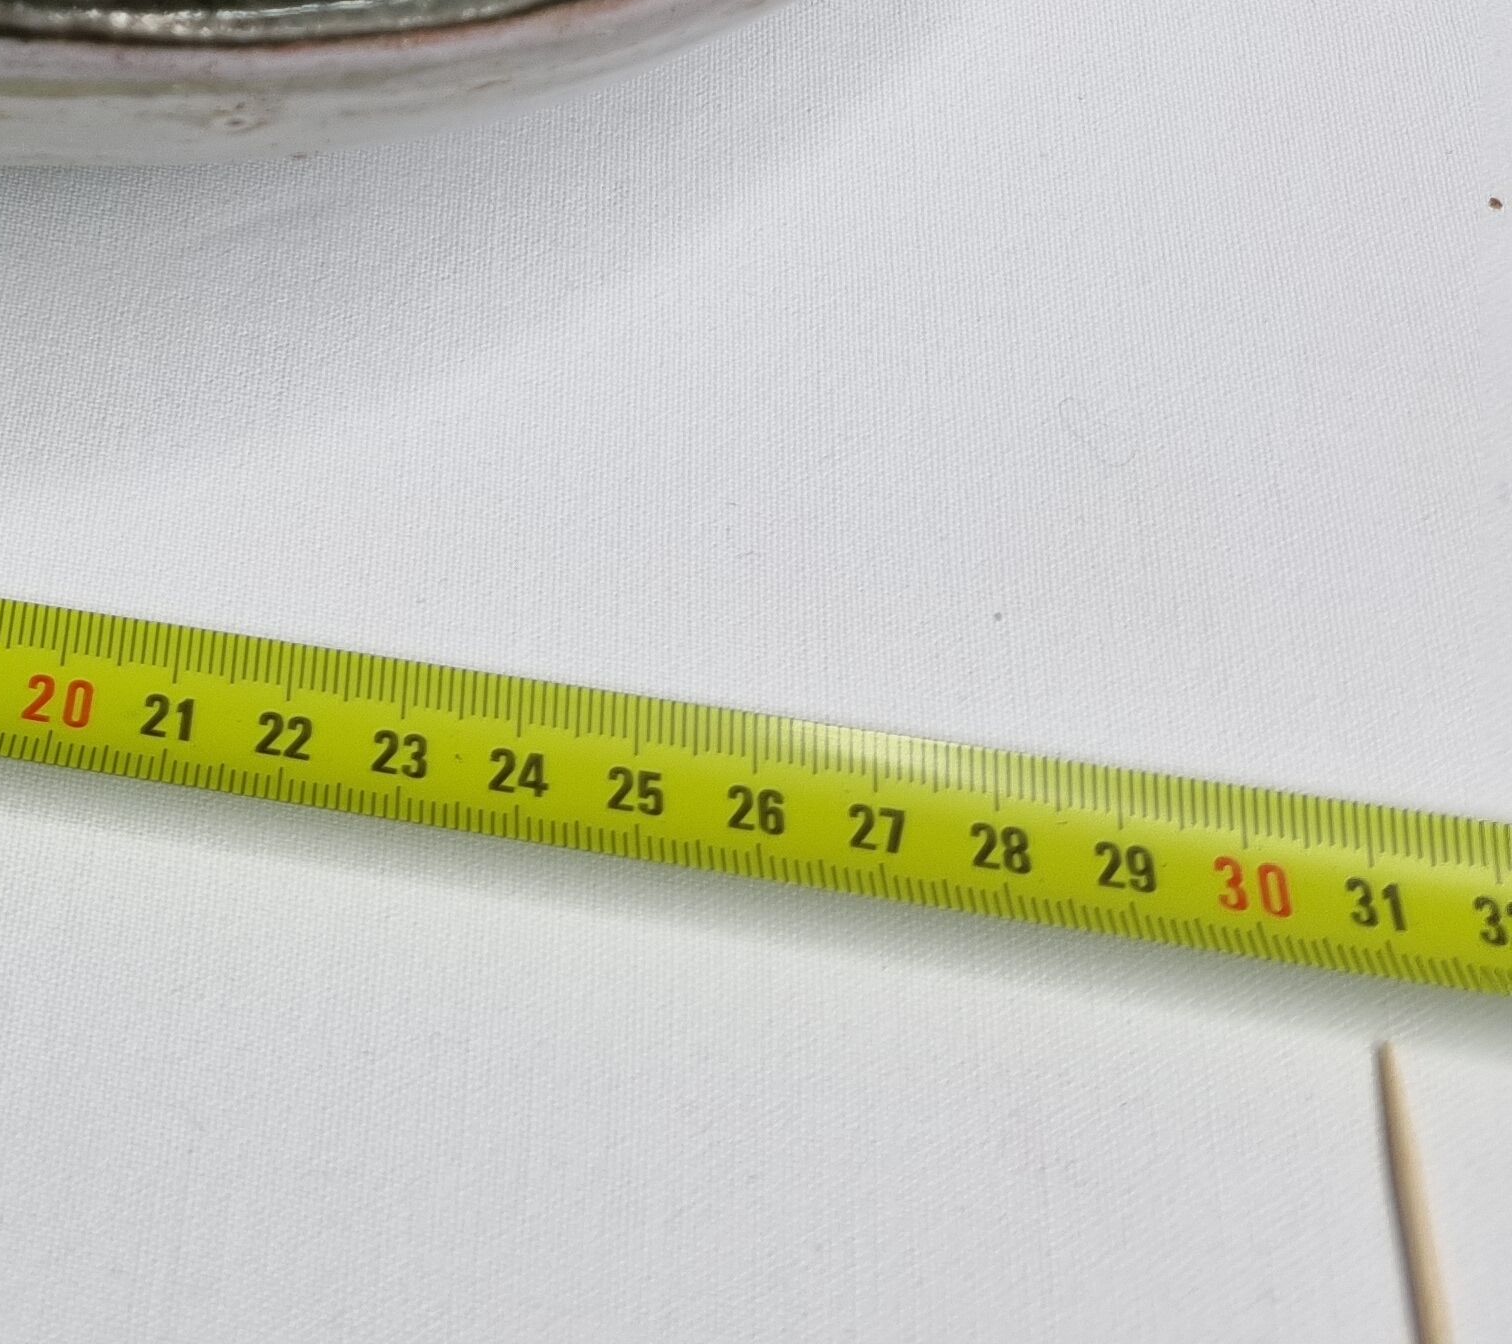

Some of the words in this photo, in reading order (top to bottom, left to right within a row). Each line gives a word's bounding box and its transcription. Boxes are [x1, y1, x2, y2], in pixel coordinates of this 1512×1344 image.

[21, 674, 96, 730] 20
[140, 694, 195, 742] 21
[255, 711, 313, 762] 22
[371, 729, 428, 780] 23
[488, 748, 549, 799] 24
[606, 766, 664, 817] 25
[726, 784, 786, 837] 26
[849, 803, 907, 855] 27
[970, 822, 1032, 875] 28
[1094, 841, 1157, 893] 29
[1214, 856, 1294, 918] 30
[1345, 877, 1408, 932] 31
[1473, 896, 1512, 946] 3
